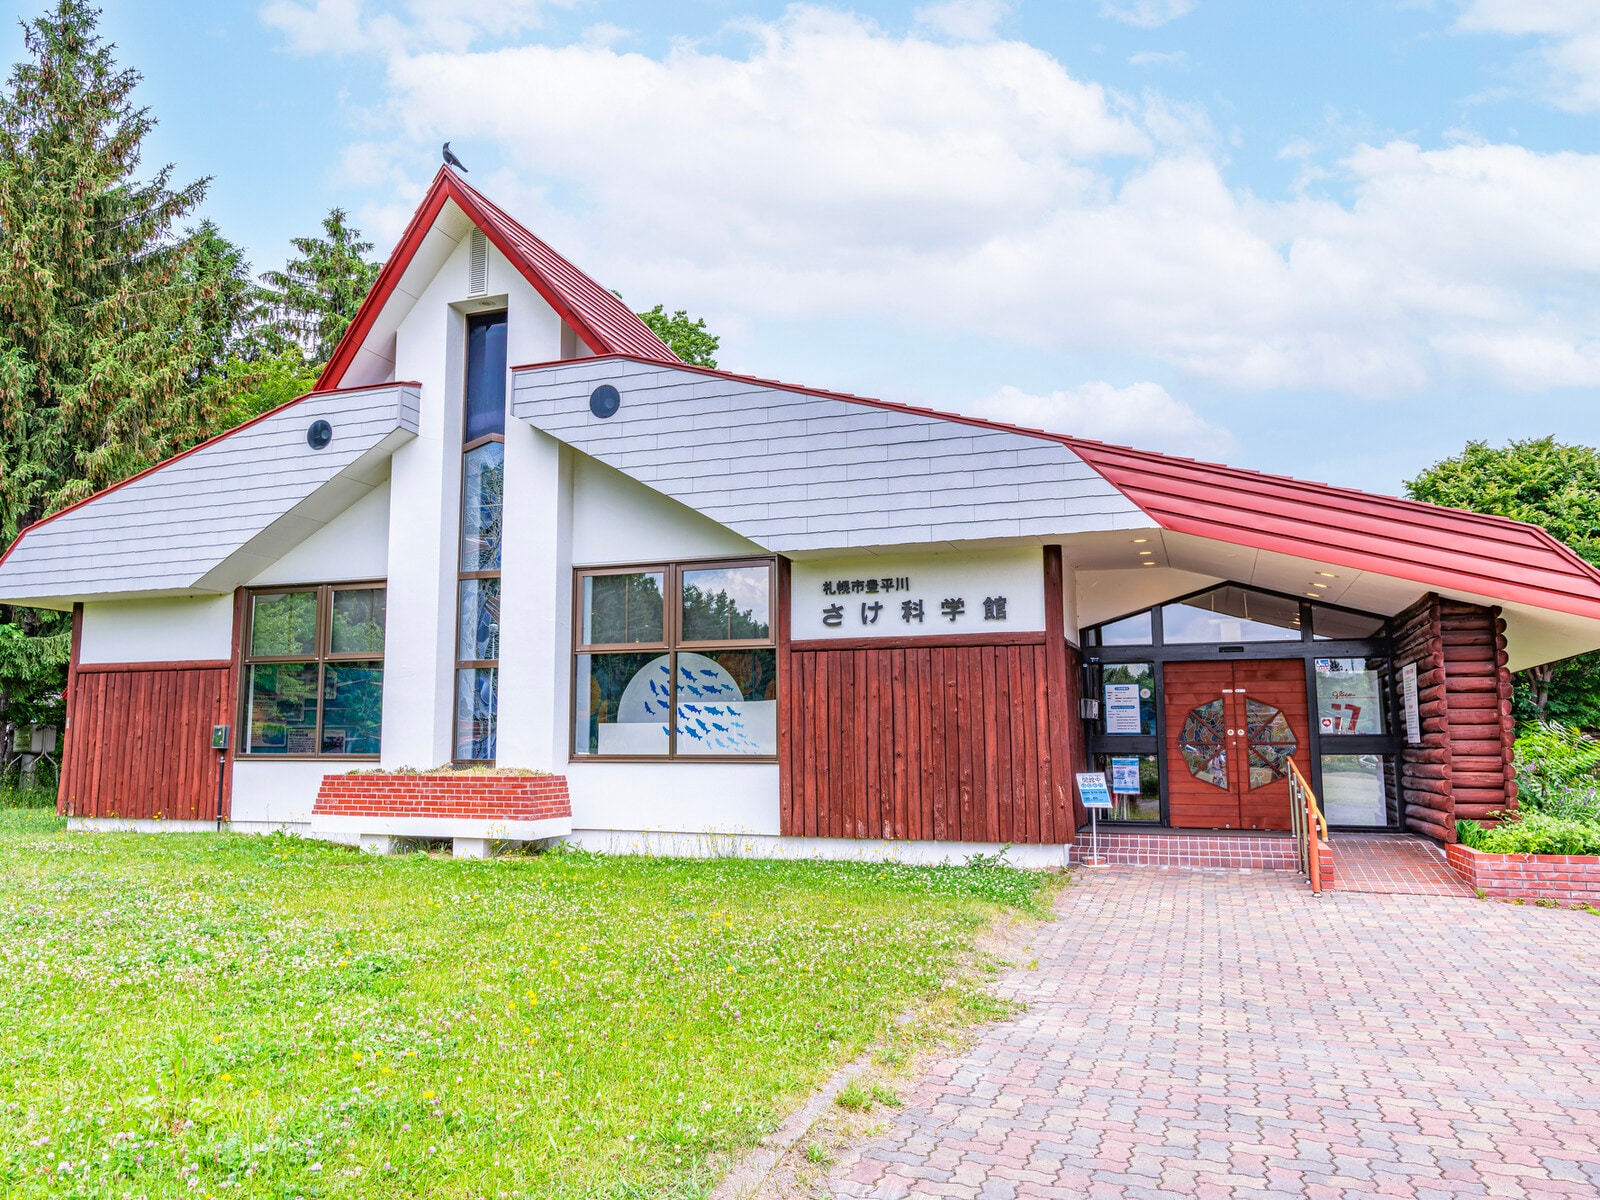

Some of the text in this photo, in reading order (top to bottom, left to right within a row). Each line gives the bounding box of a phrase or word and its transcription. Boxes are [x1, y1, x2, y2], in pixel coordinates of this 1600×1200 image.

[823, 577, 909, 595] 札幌市豊平川
[822, 596, 1007, 627] さけ科学館
